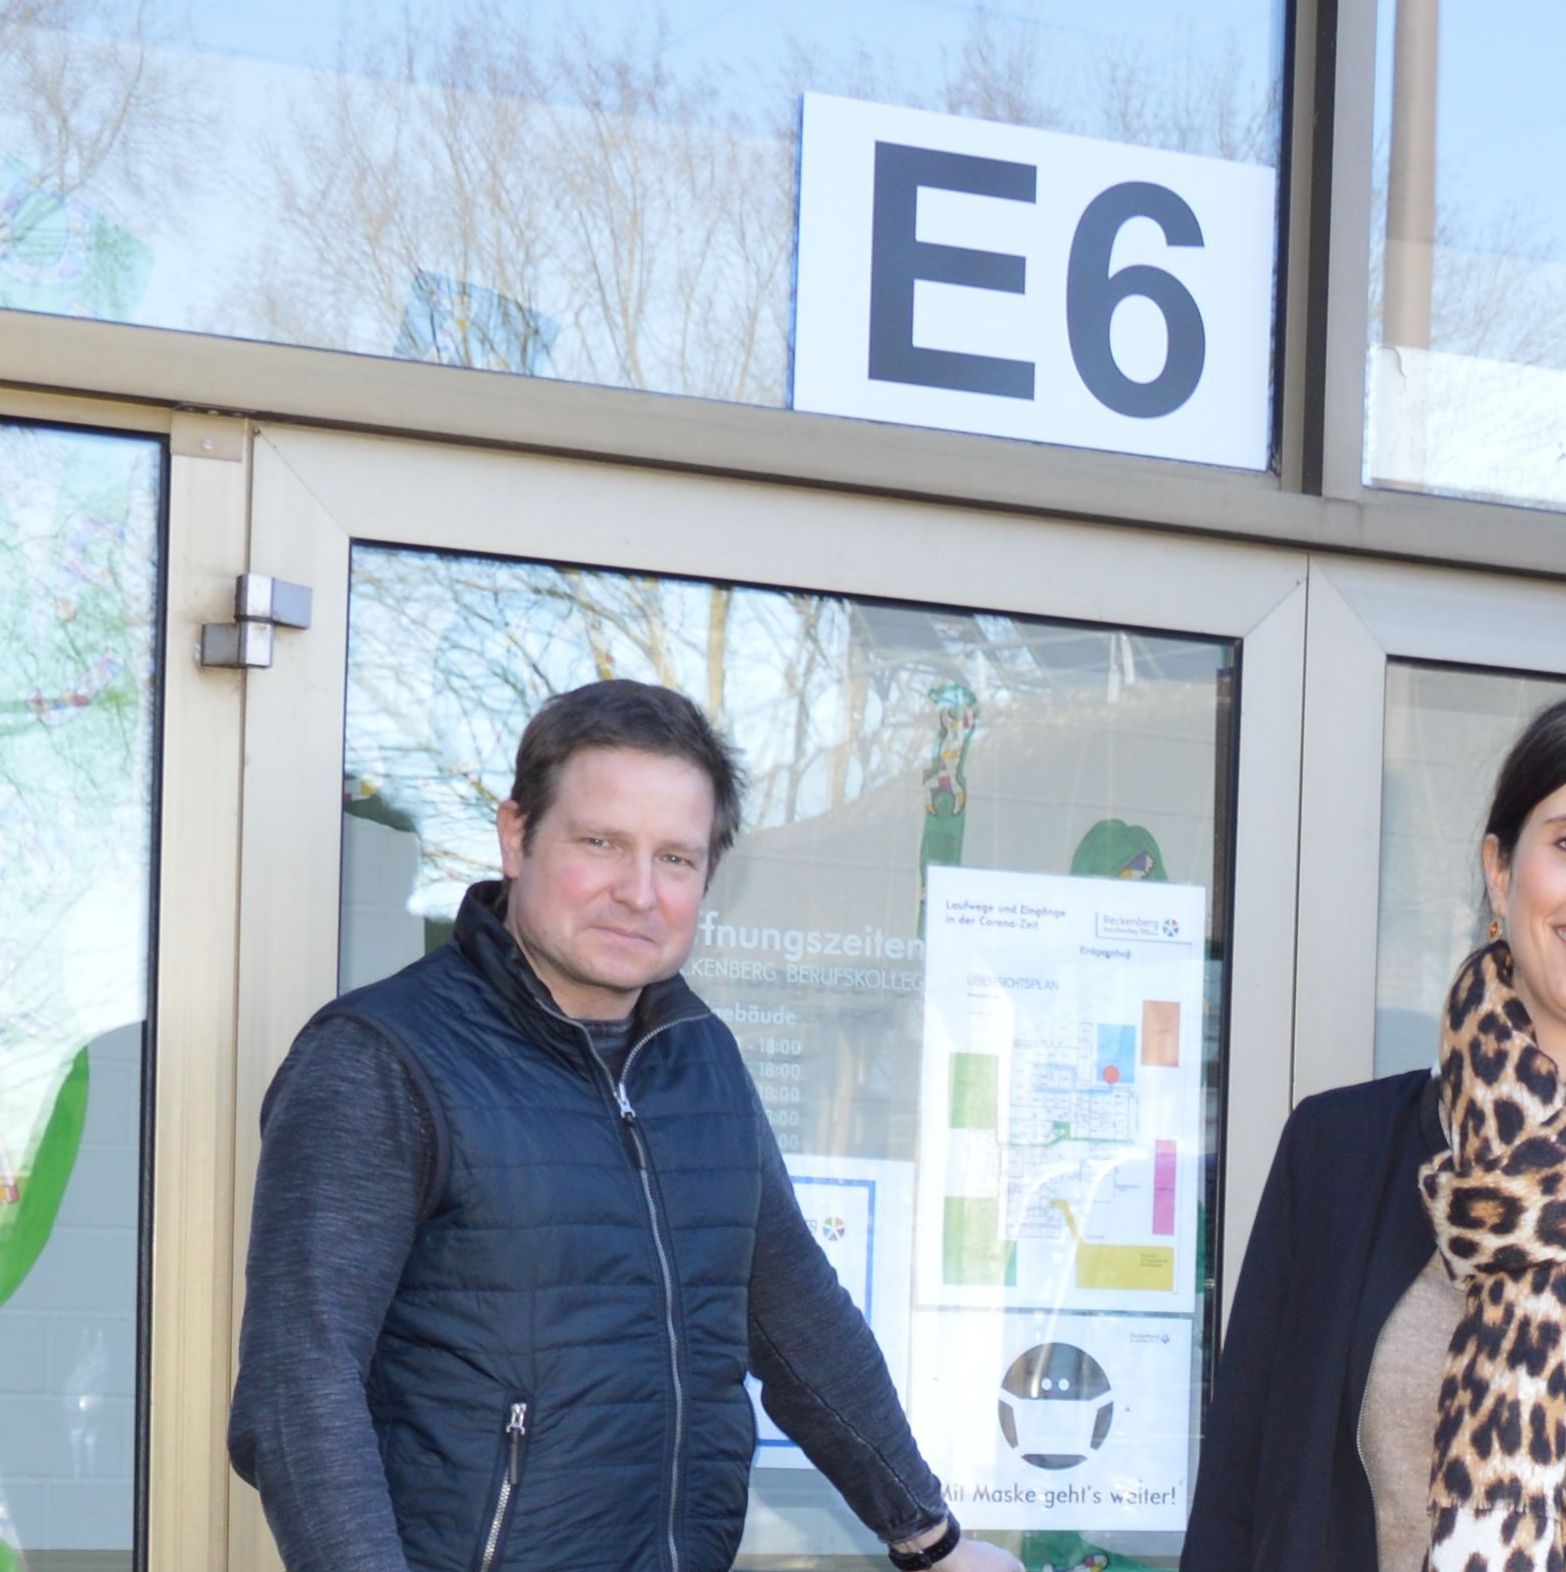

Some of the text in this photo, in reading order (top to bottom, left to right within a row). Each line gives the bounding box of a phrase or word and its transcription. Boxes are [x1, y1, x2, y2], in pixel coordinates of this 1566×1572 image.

[868, 139, 1206, 419] E6
[694, 910, 925, 962] fnungszeiten
[688, 957, 777, 982] KENBERG
[972, 1478, 1036, 1504] Maske
[1044, 1482, 1102, 1509] geht's
